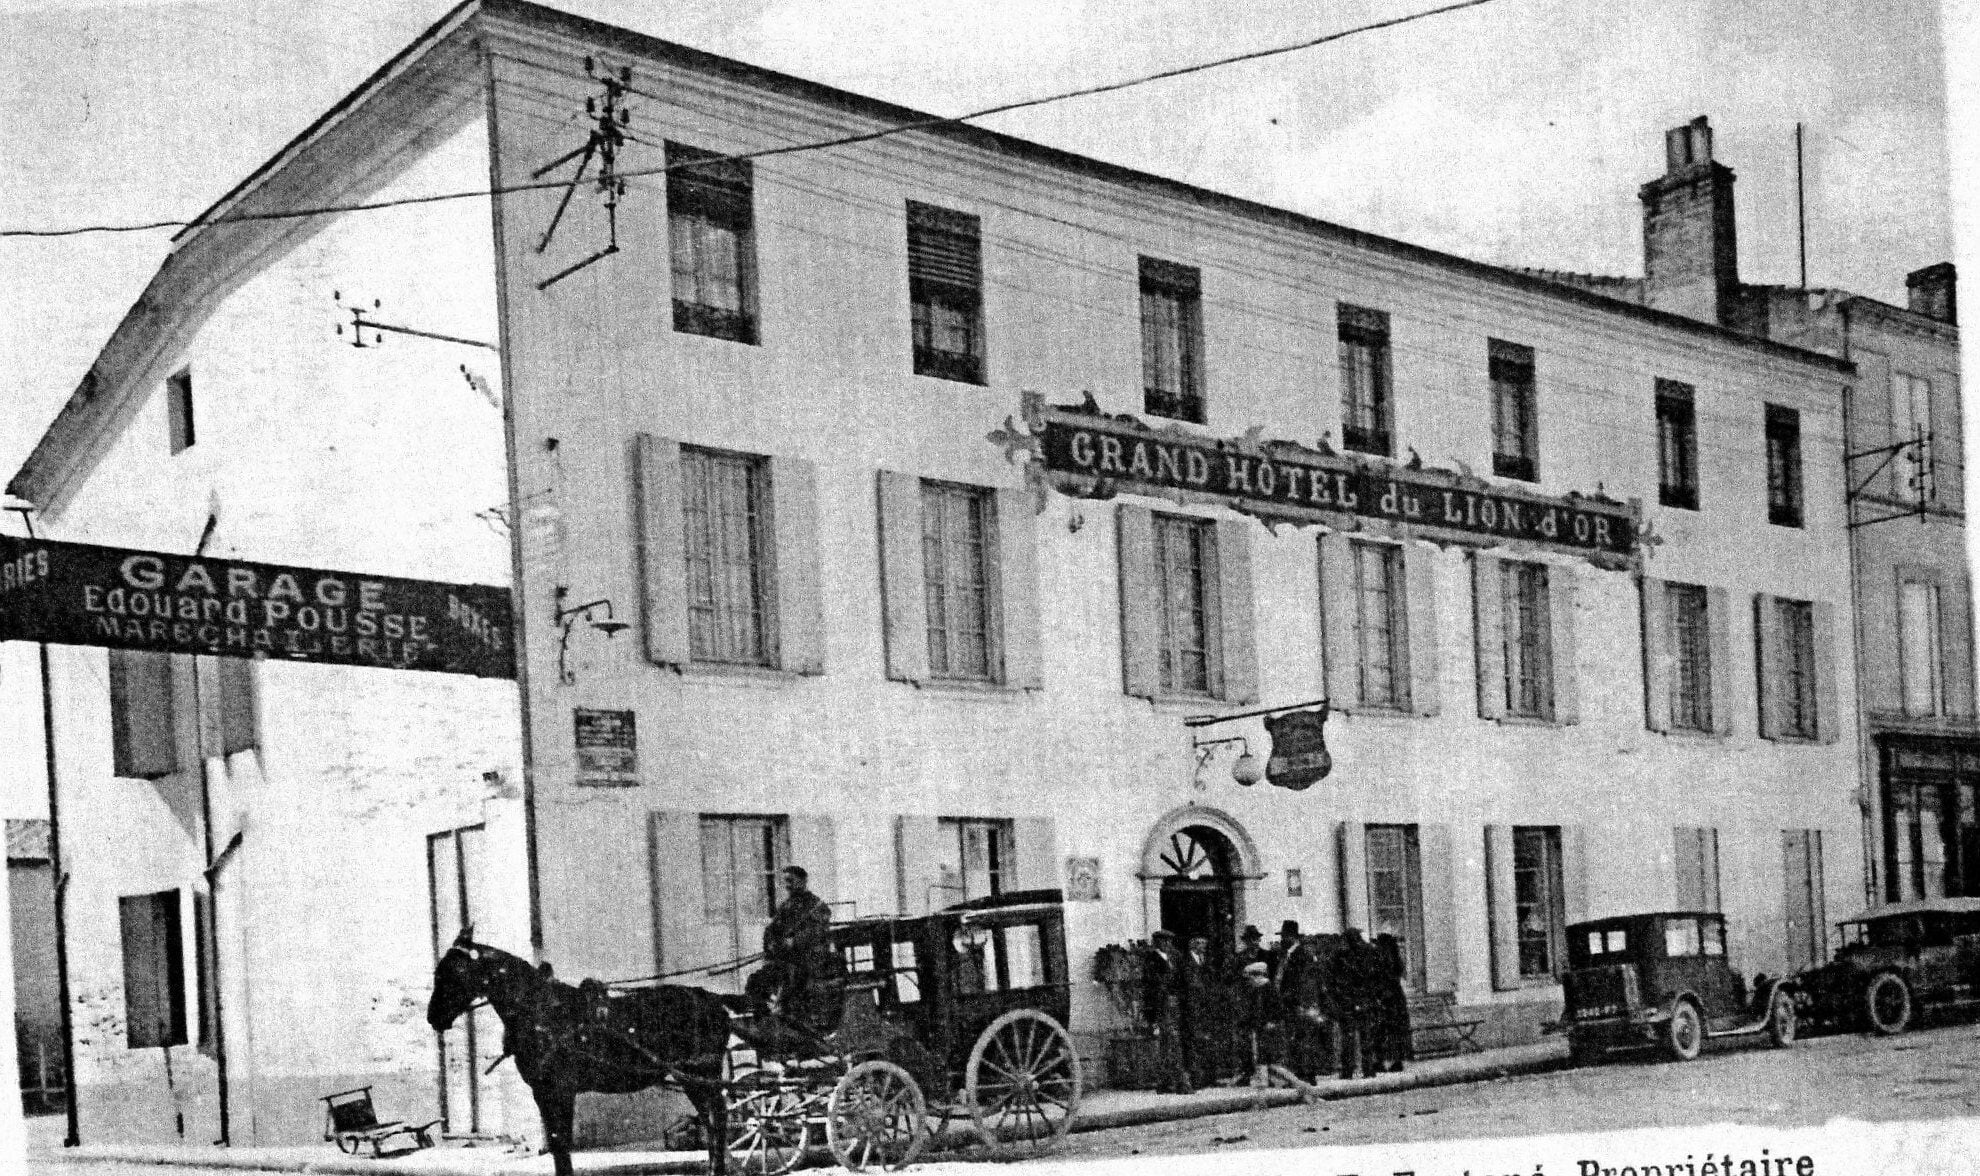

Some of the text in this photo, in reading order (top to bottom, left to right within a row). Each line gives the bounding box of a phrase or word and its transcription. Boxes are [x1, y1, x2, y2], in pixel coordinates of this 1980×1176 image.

[1071, 431, 1613, 545] GRAND HÔTEL du LION d'OR
[84, 583, 429, 640] Edouard POUSSE
[120, 555, 387, 611] GARAGE
